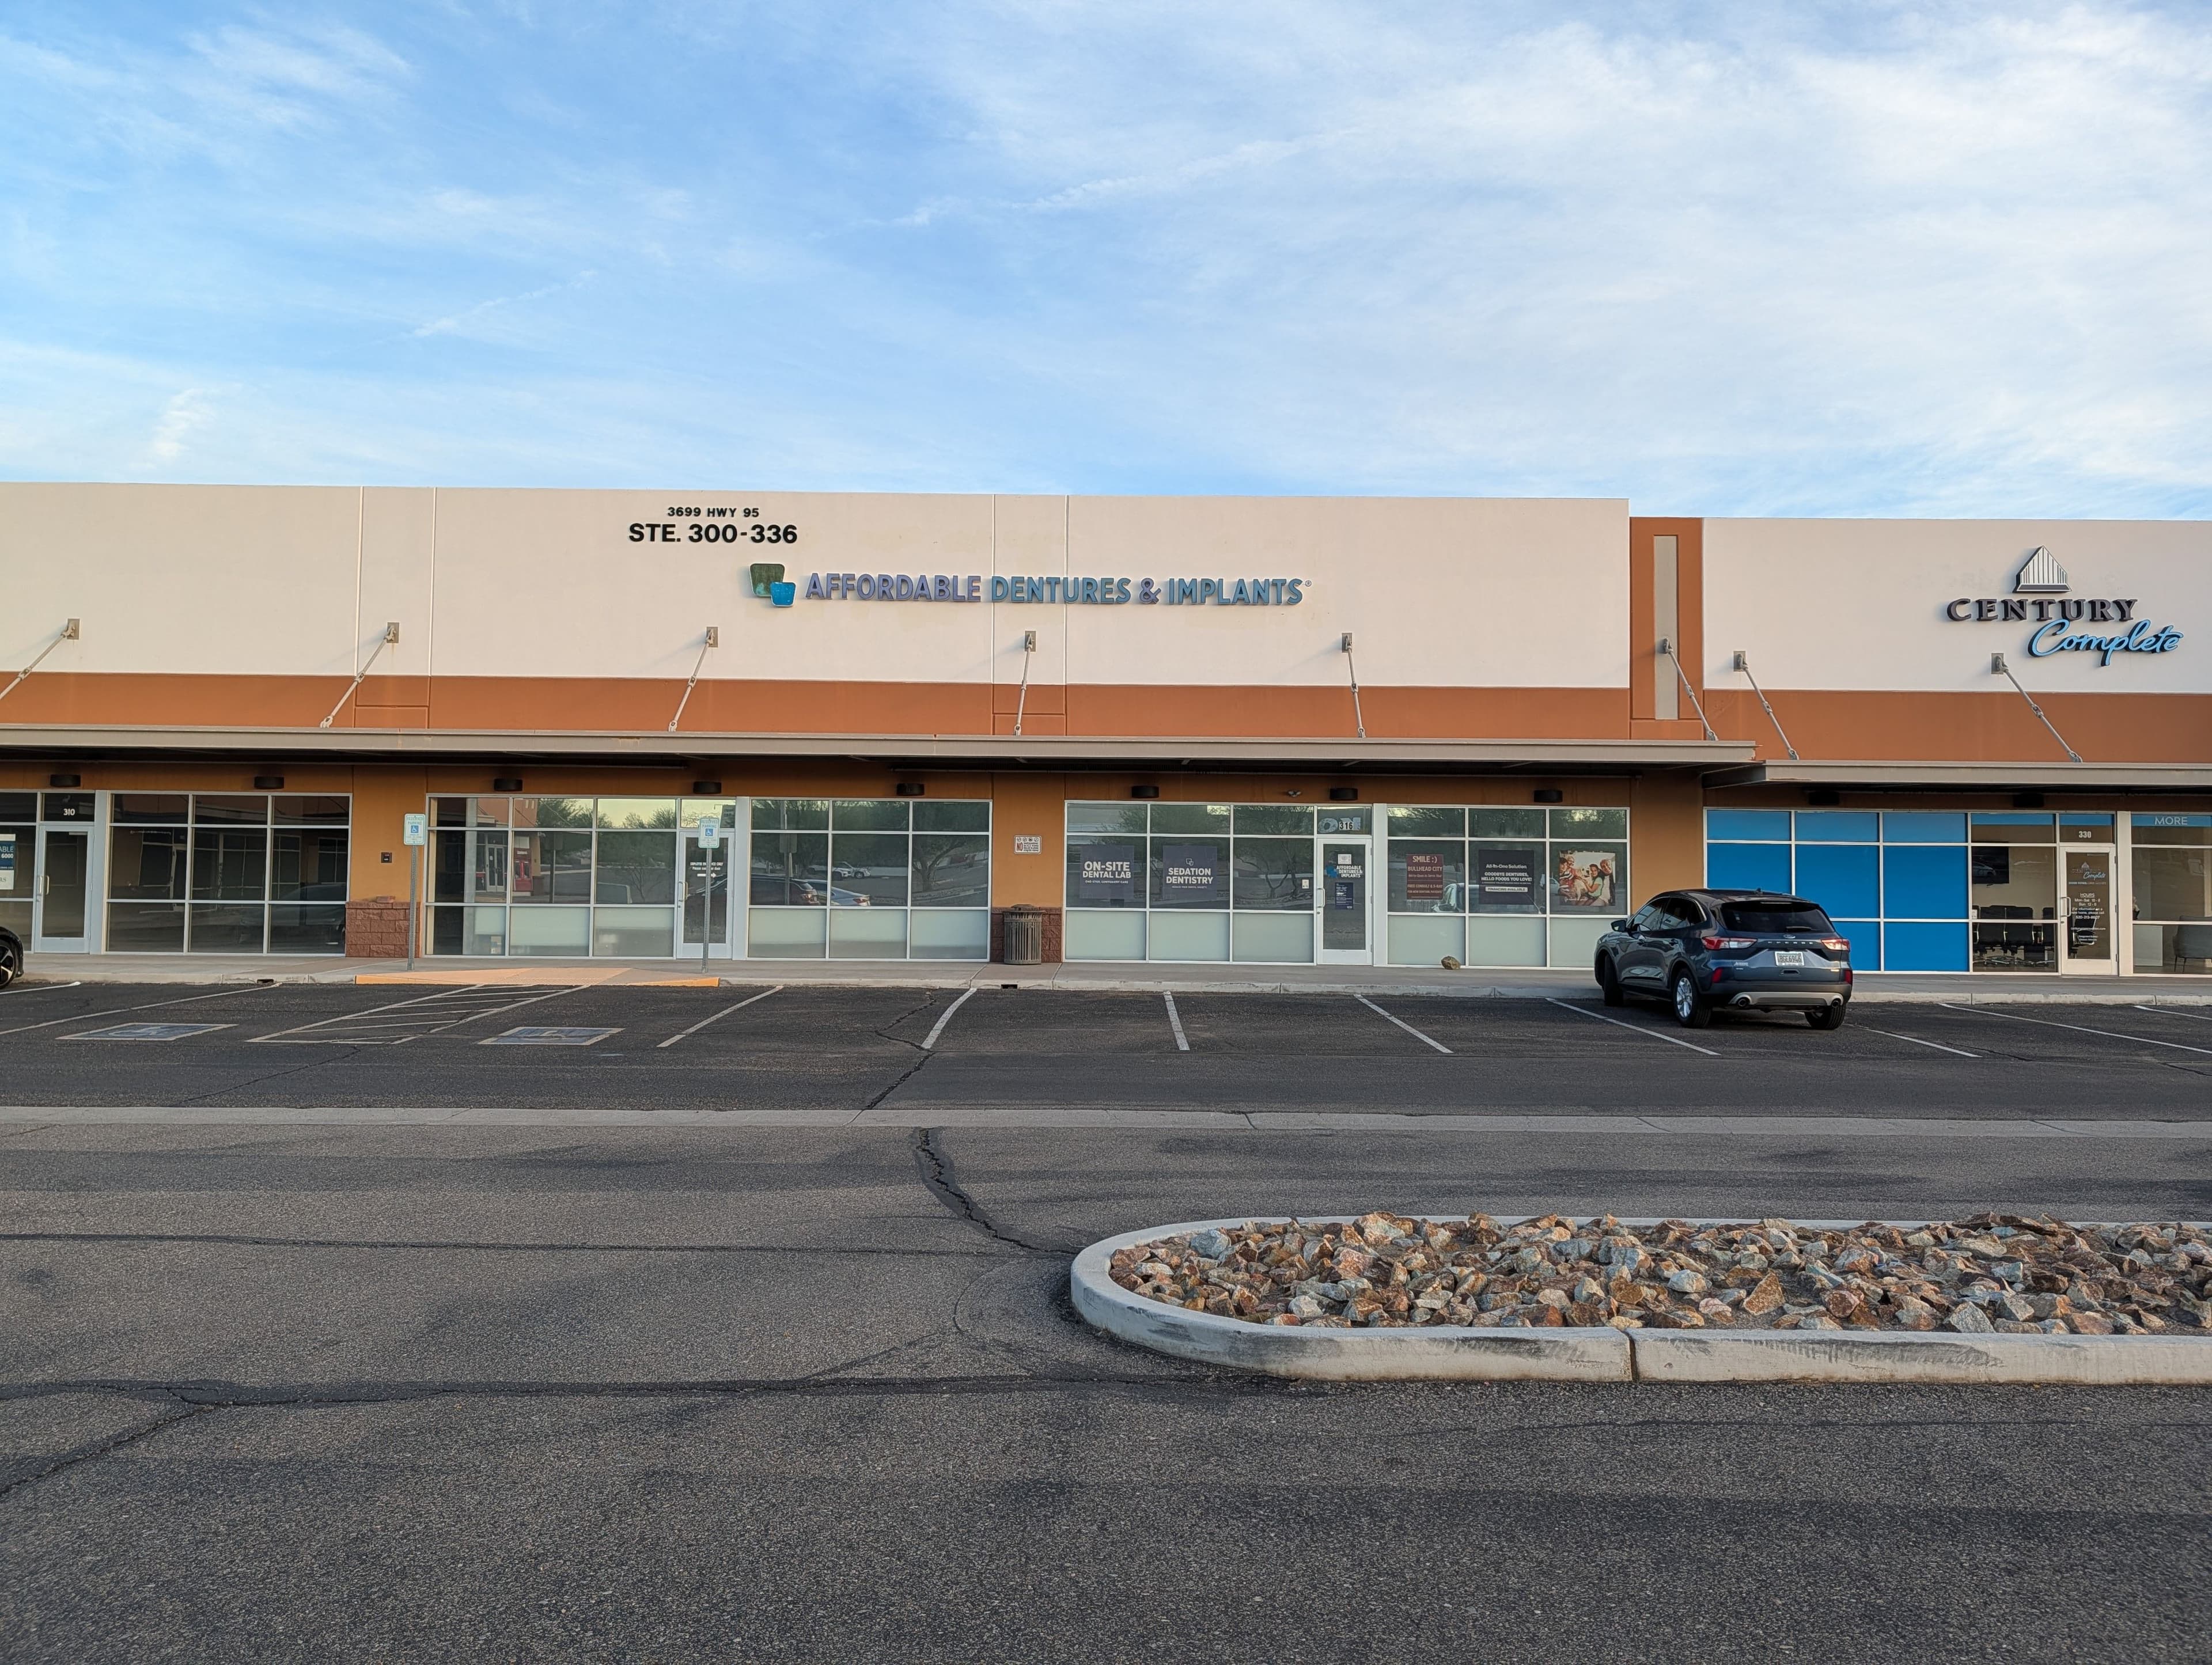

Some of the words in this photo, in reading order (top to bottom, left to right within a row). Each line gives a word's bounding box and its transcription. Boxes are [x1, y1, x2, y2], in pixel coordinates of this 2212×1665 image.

[667, 506, 702, 517] 3699
[707, 507, 737, 518] HWY
[743, 507, 759, 518] 95
[628, 523, 681, 543] STE.
[688, 524, 798, 544] 300-336
[805, 572, 982, 602] AFFORDABLE
[991, 576, 1131, 605] DENTURES
[1139, 578, 1162, 605] &
[1946, 598, 2138, 622] CENTURY
[2027, 619, 2184, 666] Complete
[1339, 822, 1353, 830] 316
[2154, 816, 2188, 825] MORE
[1016, 842, 1023, 851] NO
[1084, 860, 1130, 871] ON-SITE
[1168, 867, 1211, 875] SEDATION
[1166, 876, 1213, 884] DENTISTRY
